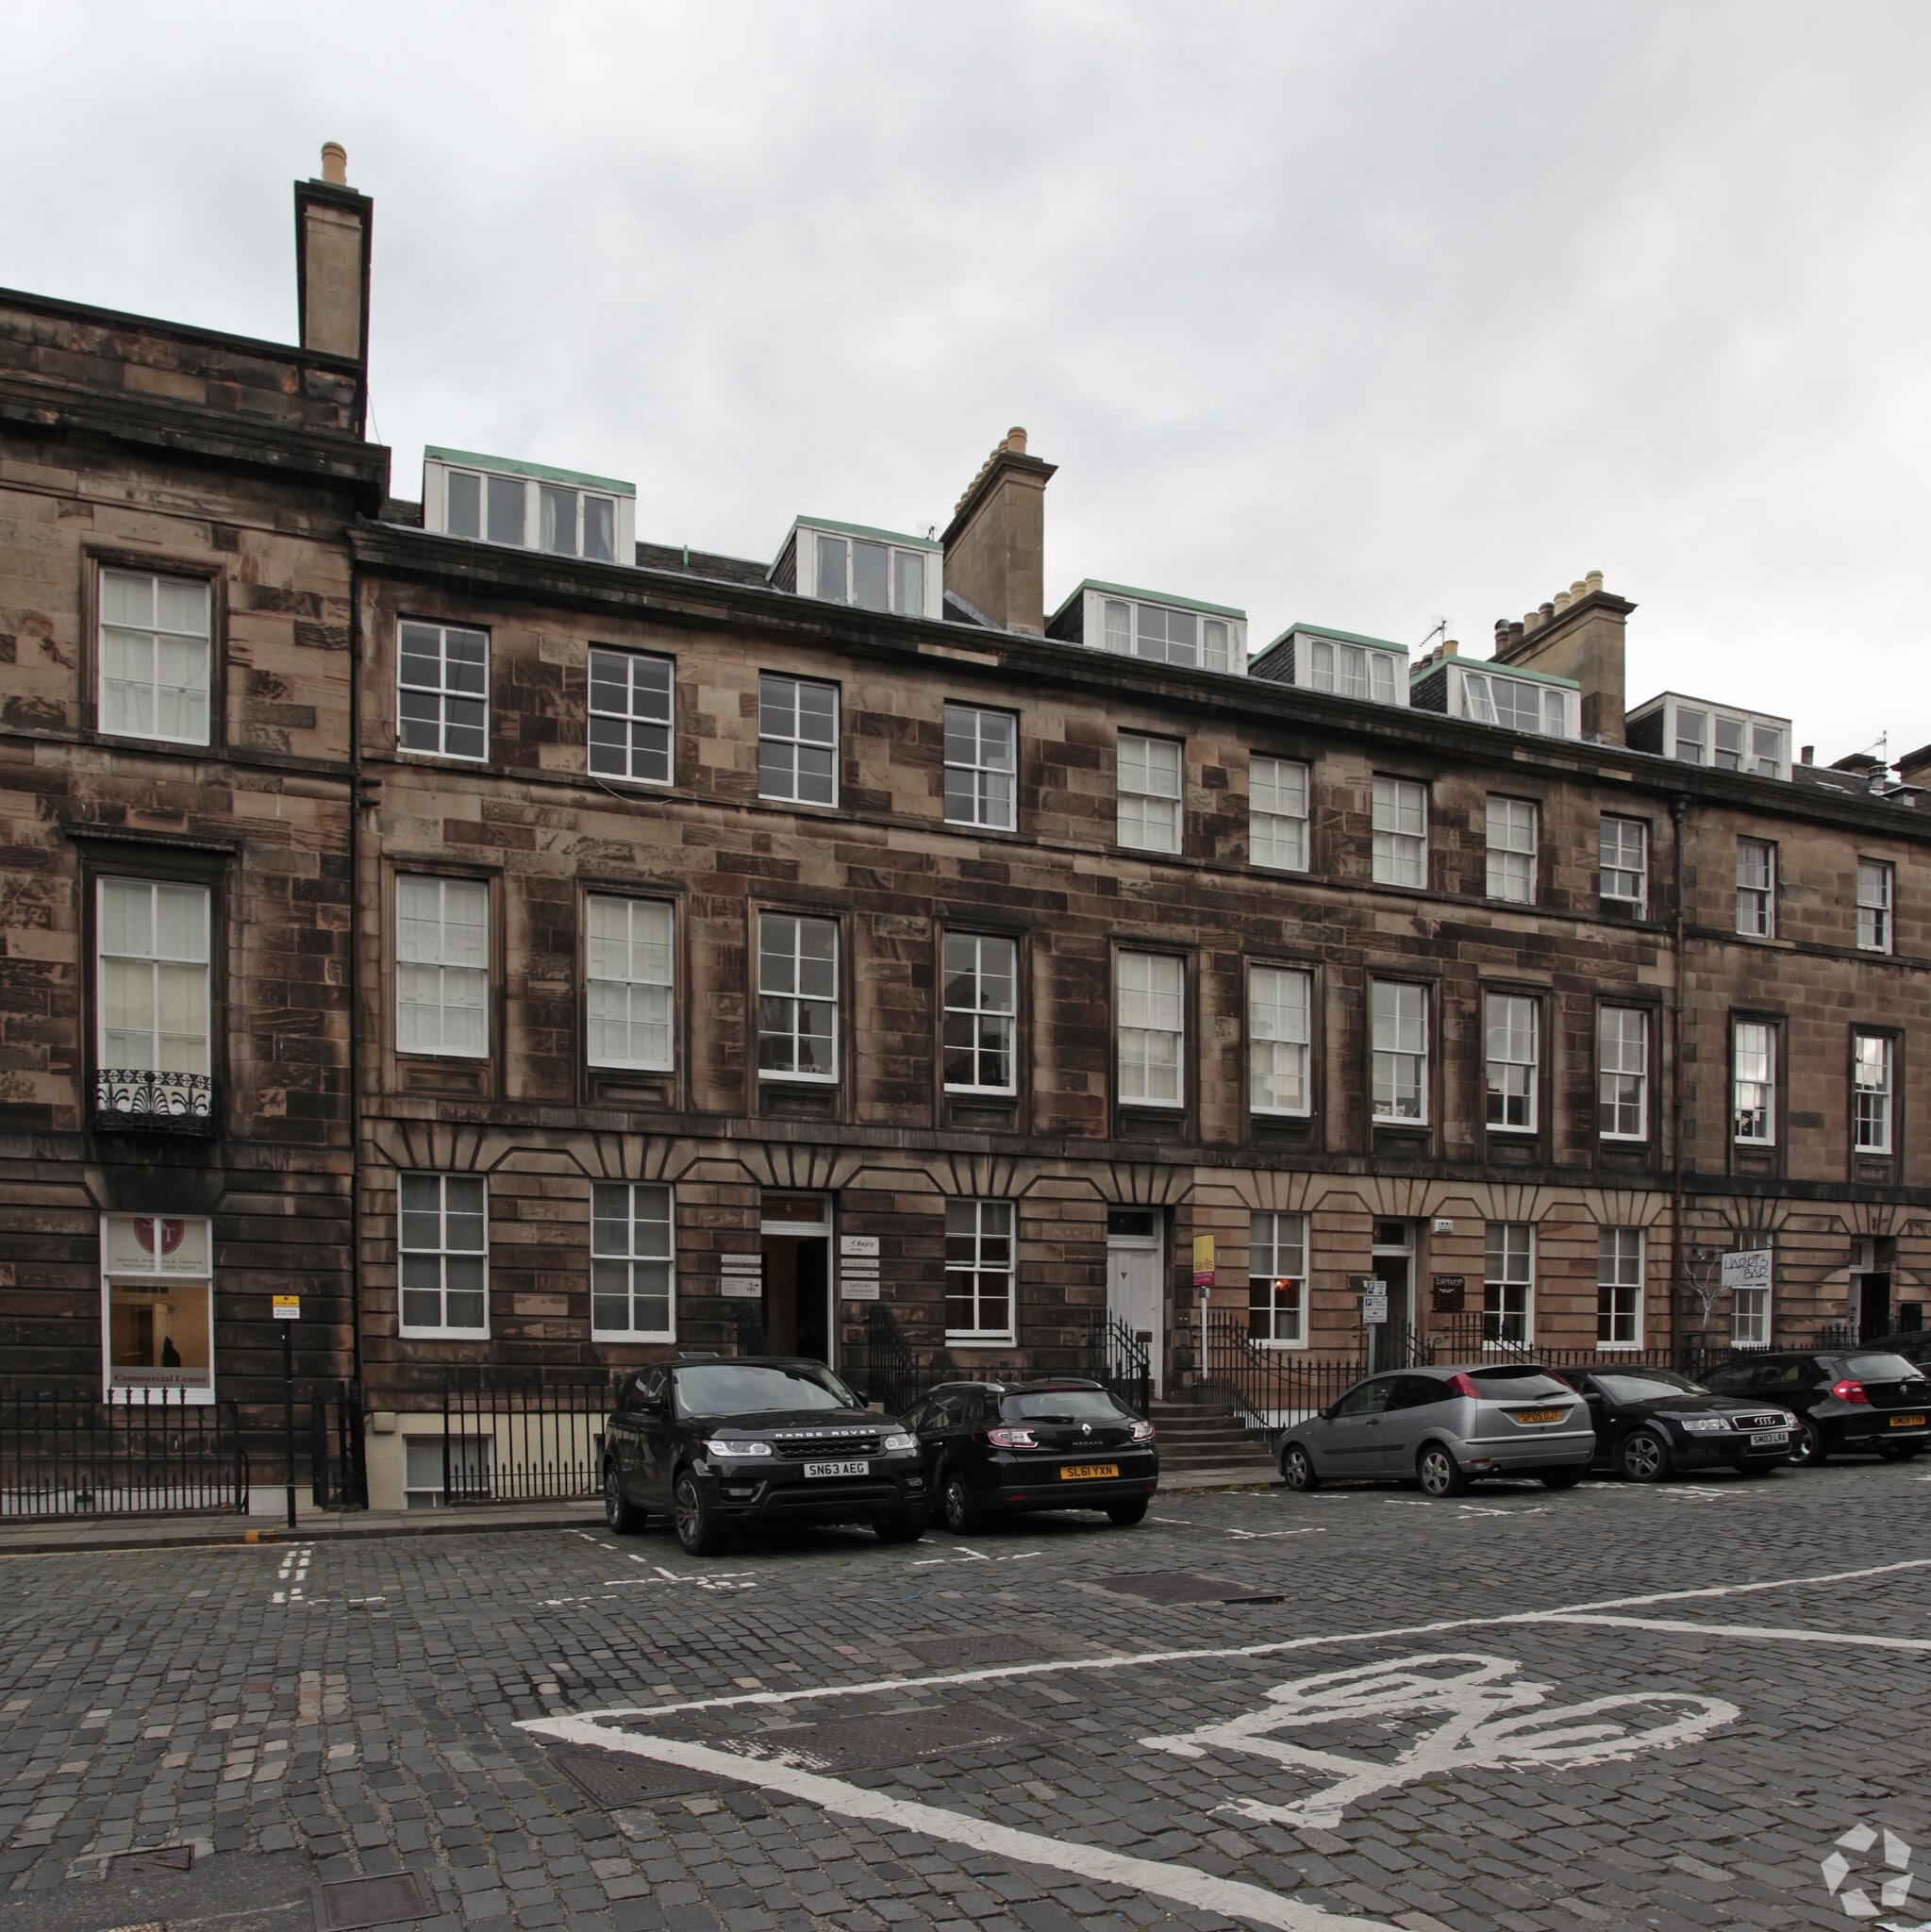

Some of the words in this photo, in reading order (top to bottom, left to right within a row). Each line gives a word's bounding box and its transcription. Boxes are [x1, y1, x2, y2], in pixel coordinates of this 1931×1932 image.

[1194, 1257, 1214, 1271] savills
[1744, 1268, 1769, 1279] BAR
[1436, 1276, 1464, 1287] Edinburgh
[114, 1374, 173, 1383] Commercial
[175, 1374, 208, 1383] Leases
[809, 1464, 840, 1475] SN63
[842, 1463, 865, 1474] AEG
[1067, 1466, 1090, 1477] SL61
[1092, 1465, 1113, 1475] YXN
